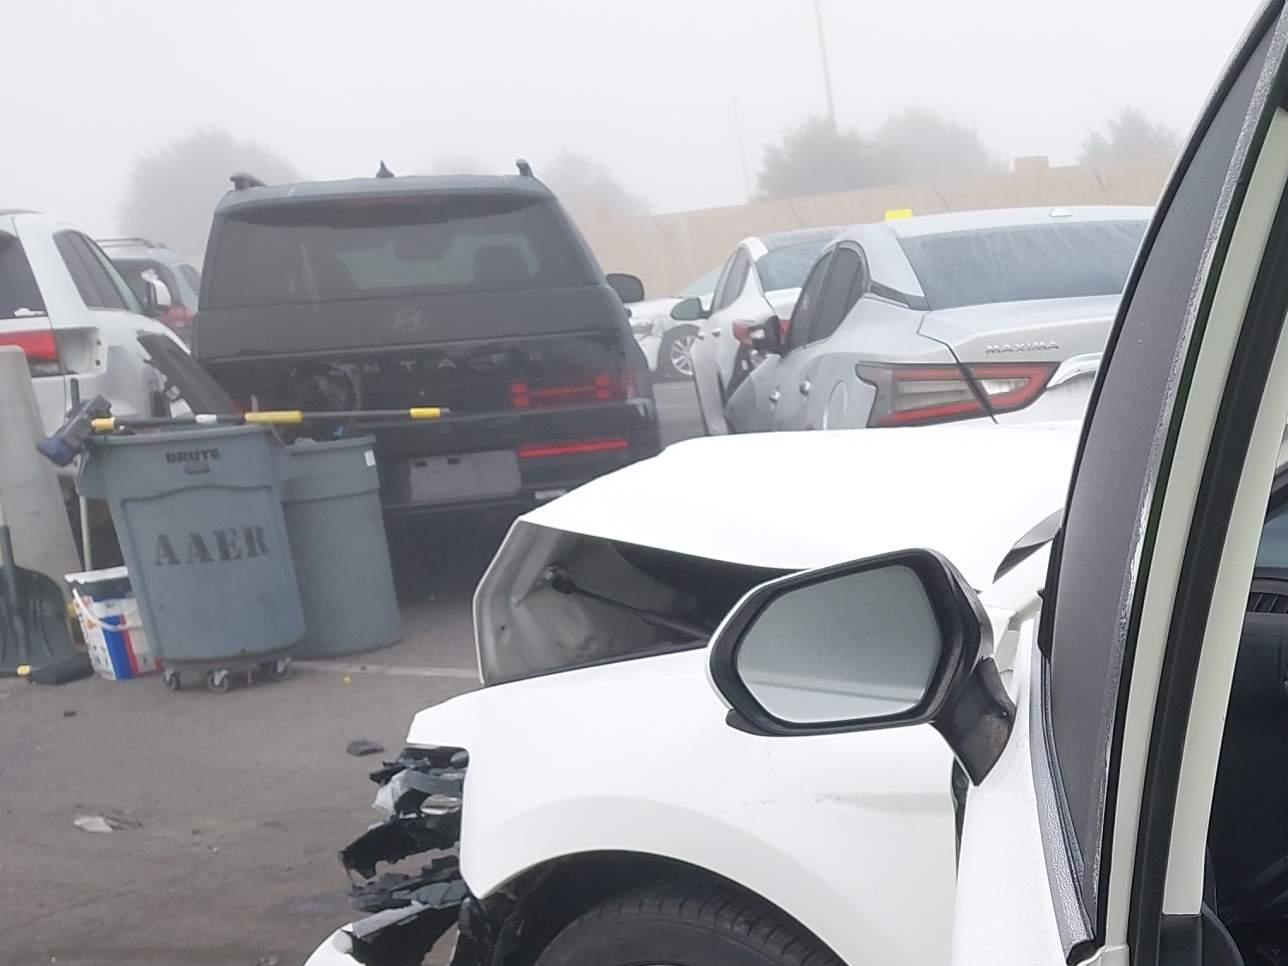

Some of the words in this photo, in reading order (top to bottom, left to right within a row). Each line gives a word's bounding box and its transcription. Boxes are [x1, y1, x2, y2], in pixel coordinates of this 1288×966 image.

[985, 339, 1060, 354] MAXIMA
[165, 448, 221, 463] BRUTE
[155, 526, 270, 565] AAER
